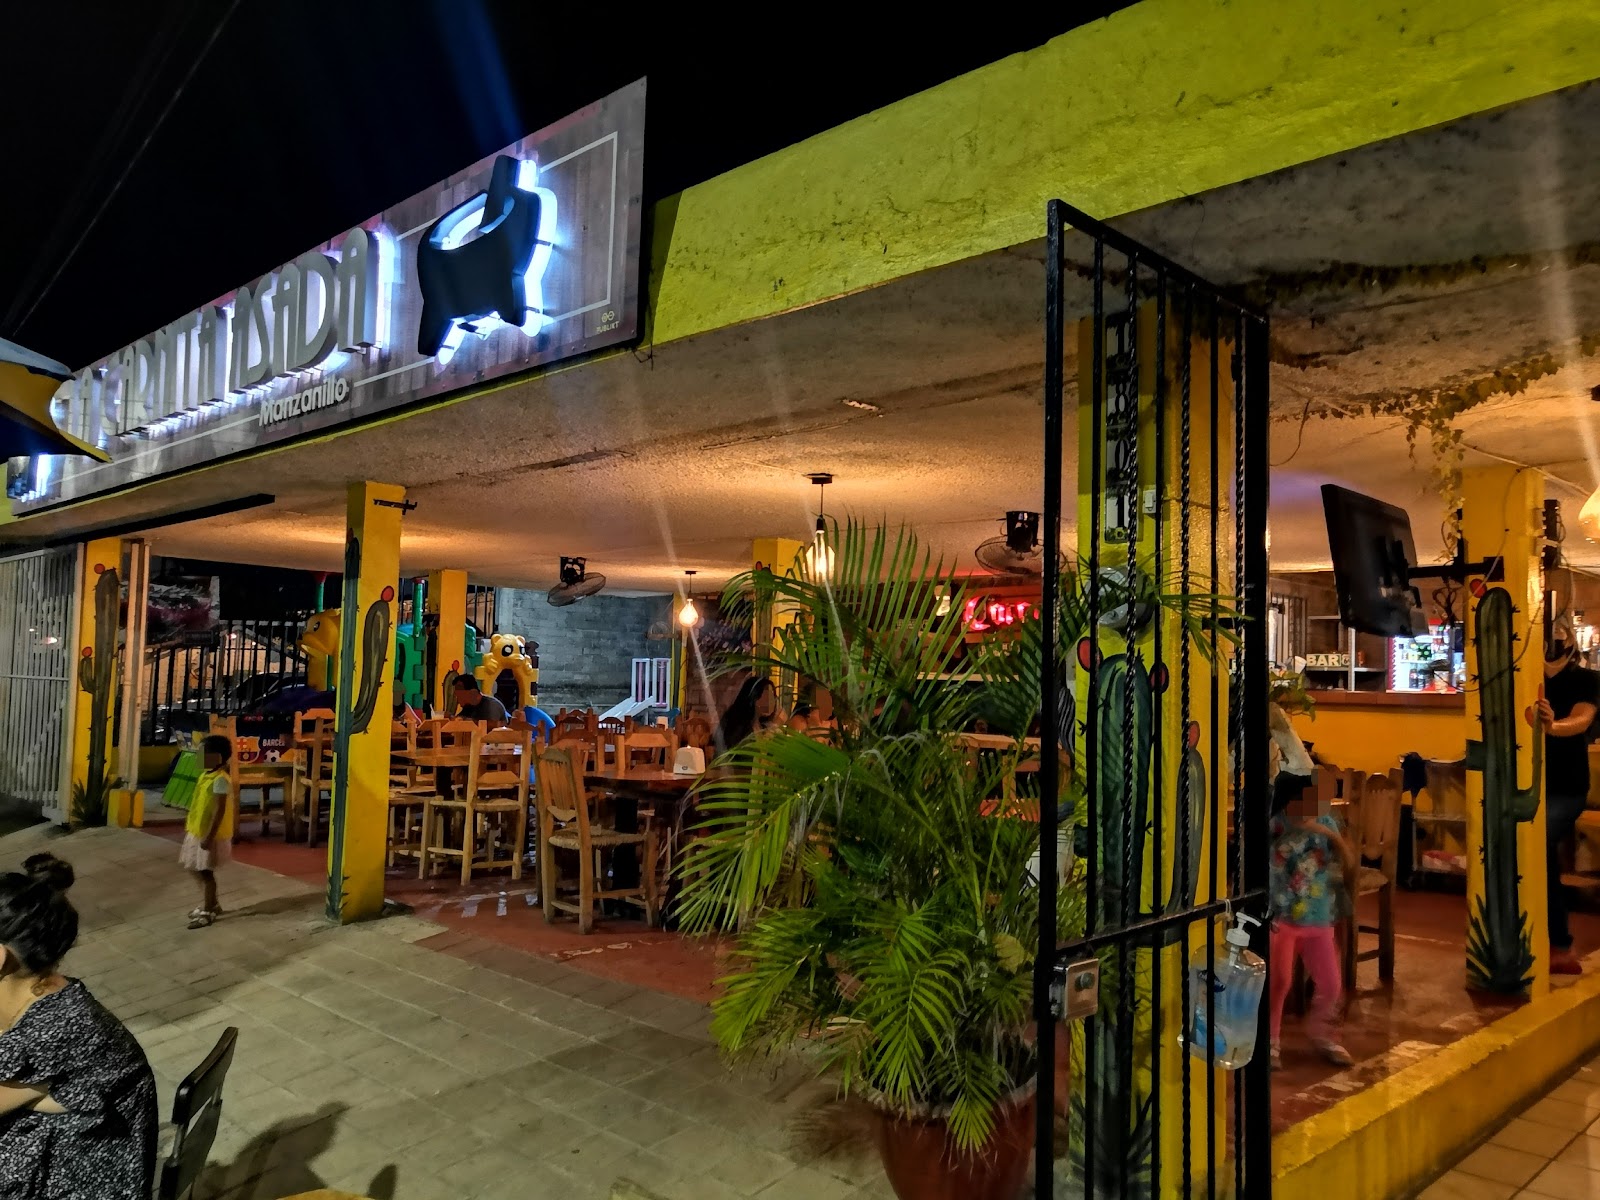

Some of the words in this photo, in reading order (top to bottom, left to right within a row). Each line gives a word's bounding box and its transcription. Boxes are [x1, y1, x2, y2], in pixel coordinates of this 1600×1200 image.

[229, 227, 372, 395] ASADA
[259, 377, 349, 426] Manzanillo
[1306, 654, 1341, 666] BAR
